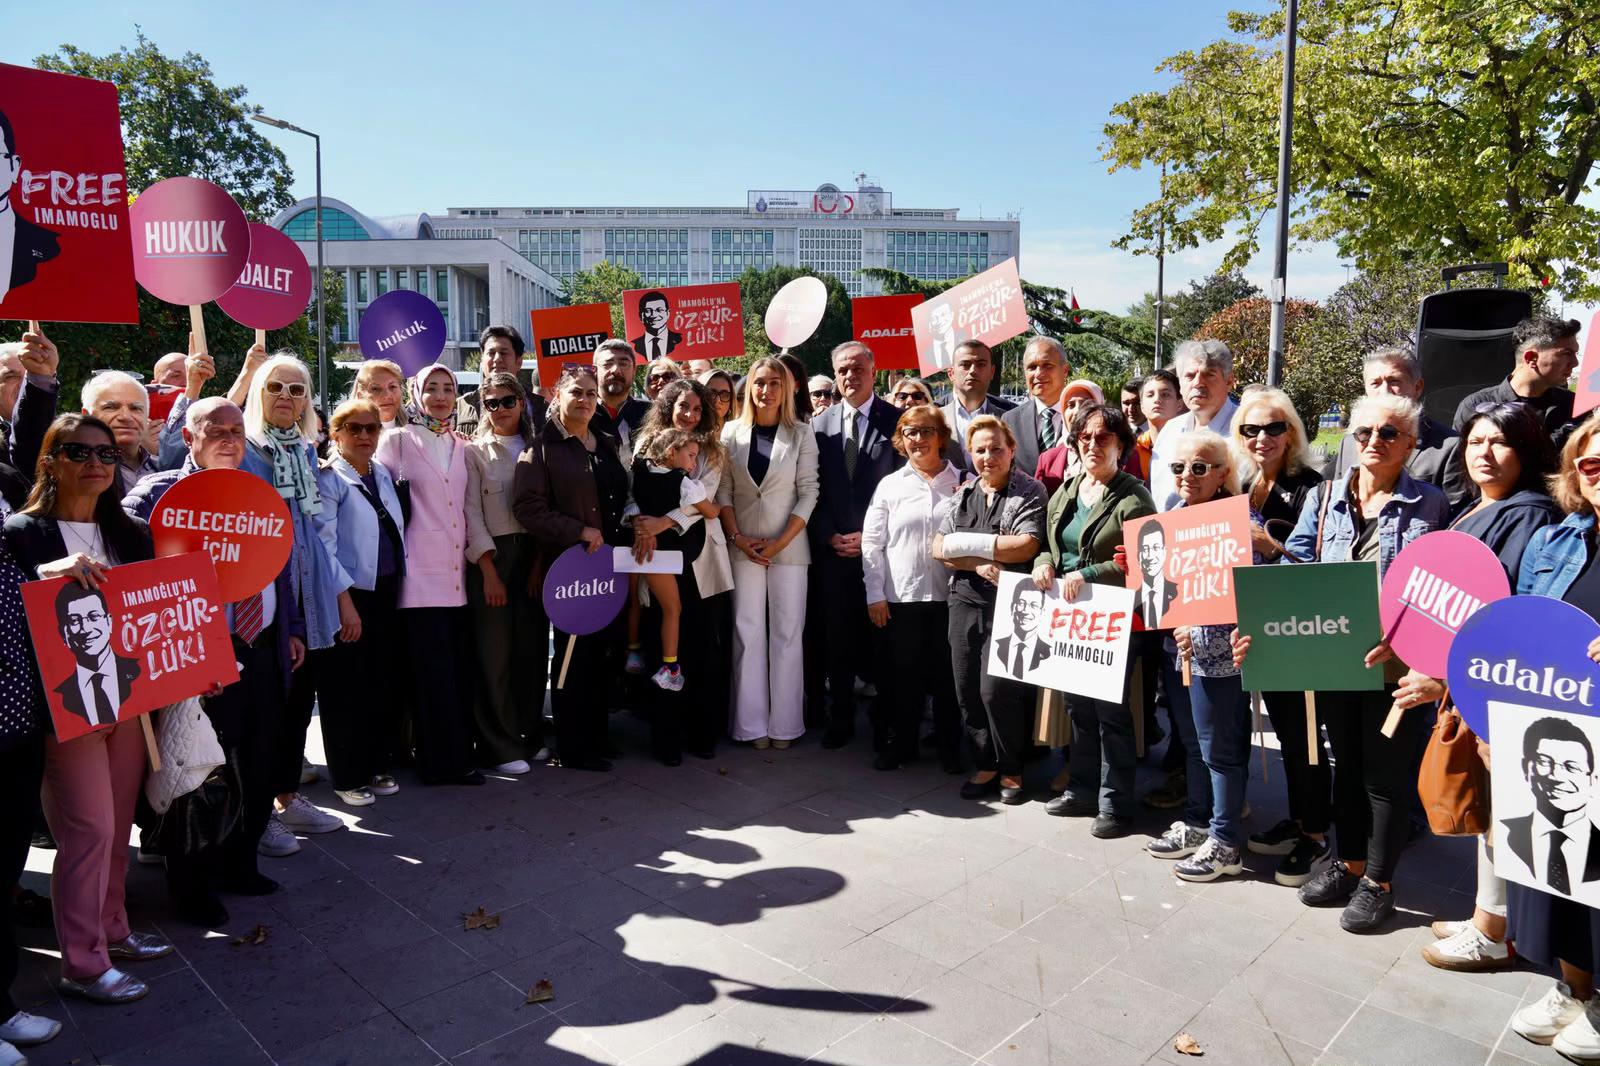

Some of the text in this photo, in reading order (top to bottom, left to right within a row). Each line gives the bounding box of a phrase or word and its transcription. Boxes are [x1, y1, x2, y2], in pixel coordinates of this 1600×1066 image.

[20, 169, 123, 206] FREE
[34, 207, 119, 231] IMAMOGLU
[144, 220, 228, 254] HUKUK
[236, 262, 293, 292] DALET
[375, 318, 428, 352] hukuk
[686, 325, 725, 347] LÜK!
[971, 306, 1007, 339] LÜK!
[549, 334, 600, 355] ADALET
[161, 507, 285, 538] GELECEĞİMİZ
[122, 579, 197, 607] İMAMOĞLU'NA
[555, 577, 616, 600] adalet
[1182, 569, 1229, 605] LÜK!
[121, 595, 219, 652] ÖZGÜR-
[1049, 607, 1126, 643] FREE
[1263, 614, 1350, 637] adalet
[147, 632, 206, 681] LÜK!
[1053, 641, 1114, 666] IMAMOGLU
[1467, 658, 1595, 707] adalet
